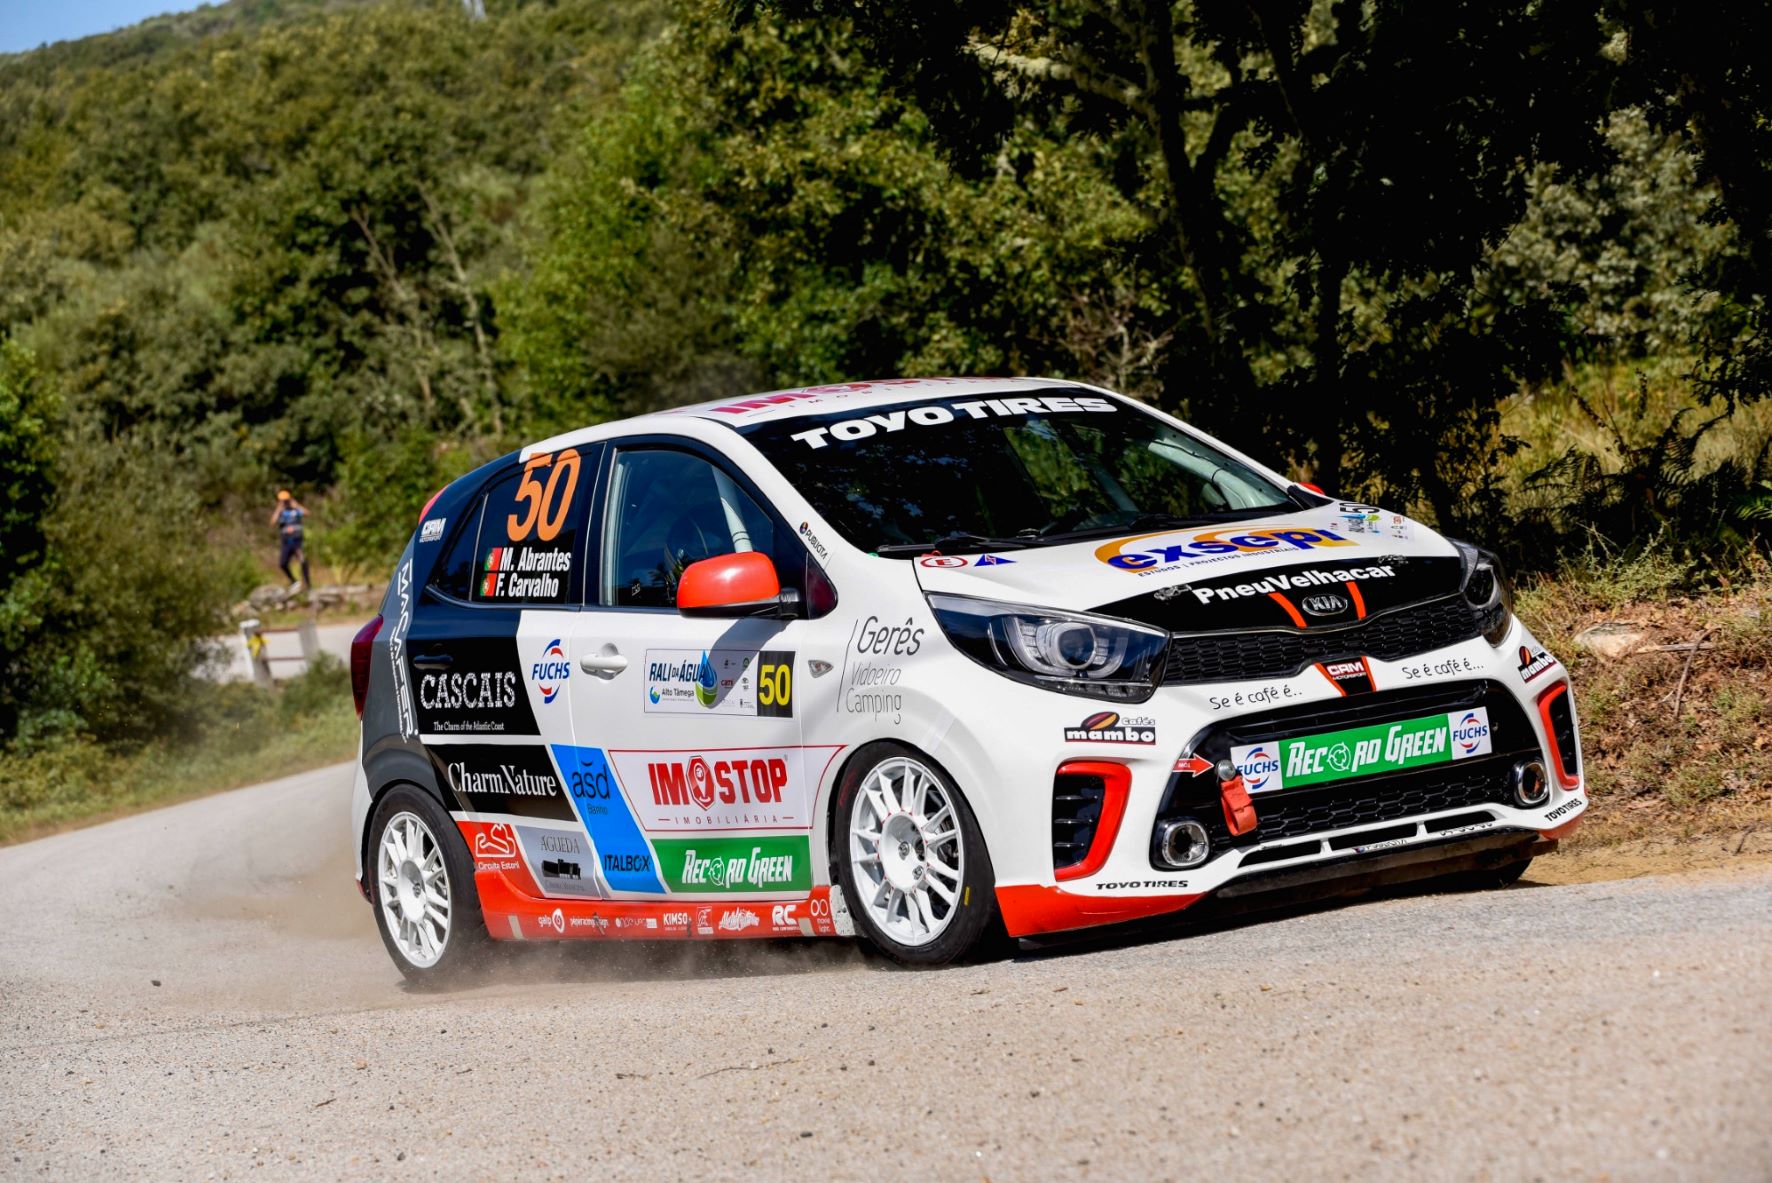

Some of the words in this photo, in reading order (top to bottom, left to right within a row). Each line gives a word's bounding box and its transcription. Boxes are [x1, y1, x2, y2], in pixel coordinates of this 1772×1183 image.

[790, 406, 954, 450] TOYO
[951, 397, 1118, 419] TIRES
[507, 449, 581, 541] 50
[499, 547, 515, 571] M.
[517, 547, 572, 571] Abrantes
[496, 573, 505, 597] F.
[508, 573, 560, 598] Carvalho
[1192, 565, 1396, 605] PneuVelhacar
[1309, 596, 1343, 610] KIA
[857, 616, 925, 656] Gerês
[532, 662, 570, 680] FUCHS
[649, 663, 671, 682] RALI
[678, 659, 706, 682] ÁGUA
[1326, 661, 1365, 675] CRM
[1402, 667, 1421, 679] Se
[1423, 664, 1432, 676] é
[1434, 660, 1462, 676] café
[1520, 655, 1555, 681] mambo
[420, 671, 516, 709] CASCAIS
[662, 688, 673, 697] Alto
[673, 687, 695, 698] Tâmega
[759, 664, 791, 706] 50
[845, 687, 902, 725] Camping
[1209, 697, 1231, 710] Se
[1235, 692, 1244, 705] é
[1248, 687, 1279, 704] café
[1066, 727, 1155, 743] mambo
[1385, 725, 1448, 765] GREEN
[1453, 725, 1489, 742] FUCHS
[1236, 759, 1279, 776] FUCHS
[447, 762, 558, 797] CharmNature
[674, 814, 779, 826] IMOBILIÁRIA
[1544, 806, 1567, 822] TOYO
[1561, 798, 1583, 811] TIRES
[604, 854, 650, 873] ITALBOX
[747, 847, 793, 889] GREEN
[1096, 880, 1141, 890] TOYO
[1142, 880, 1189, 889] TIRES
[663, 911, 689, 926] KIMSO
[771, 904, 798, 926] RC
